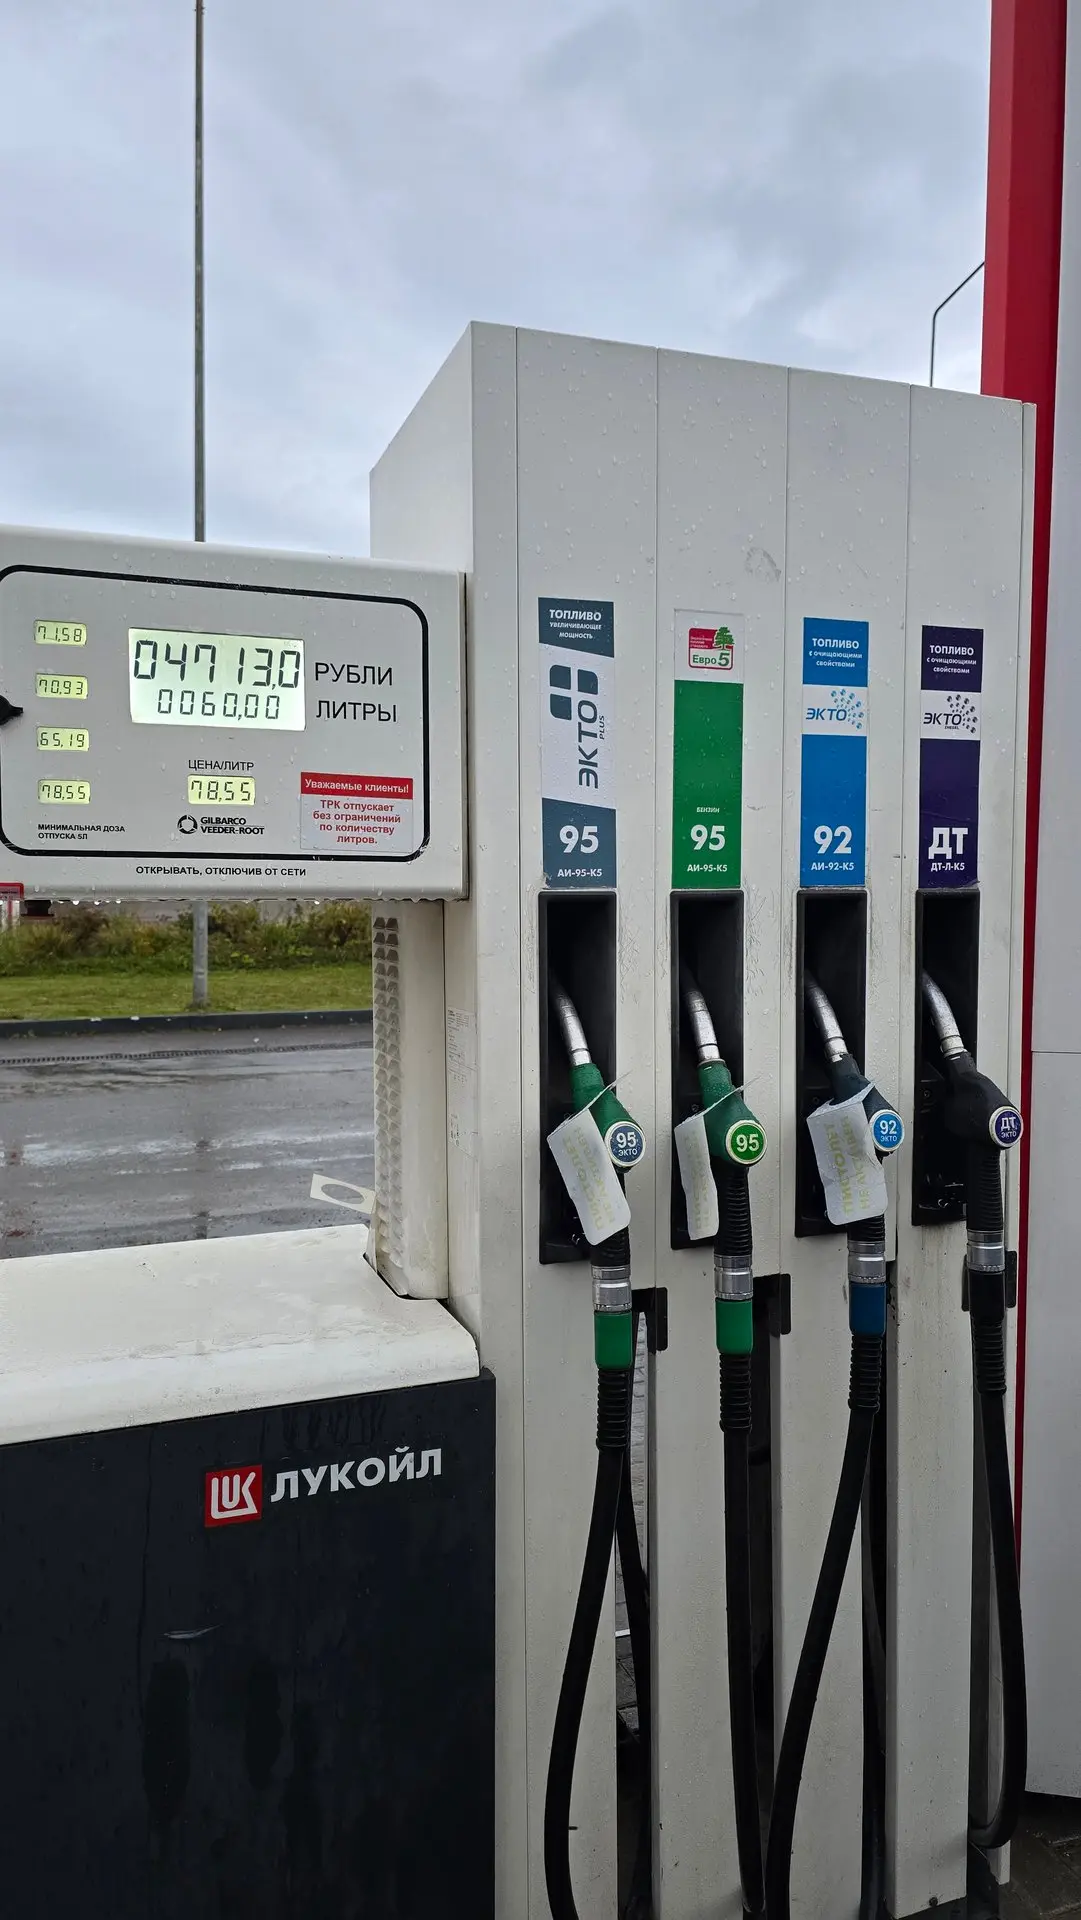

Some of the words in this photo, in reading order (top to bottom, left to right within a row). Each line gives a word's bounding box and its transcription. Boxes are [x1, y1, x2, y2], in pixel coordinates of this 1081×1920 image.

[549, 609, 602, 622] ТОПЛИВО
[38, 626, 82, 642] 71,58
[812, 638, 859, 650] ТОПЛИВО
[929, 645, 974, 656] ТОПЛИВО
[133, 639, 301, 690] 04713,0
[692, 654, 717, 666] Евро
[718, 652, 730, 667] 5
[314, 662, 393, 687] РУБЛИ
[39, 679, 84, 695] 70,93
[157, 688, 281, 721] 0060,00
[316, 700, 398, 723] ЛИТРЫ
[805, 707, 848, 721] ЭКТО
[923, 712, 962, 726] ЭКТО
[40, 732, 85, 748] 65,19
[578, 700, 599, 789] ЭКТО
[188, 760, 255, 771] ЦЕНА/ЛИТР
[42, 785, 86, 800] 78,55
[190, 780, 251, 802] 78,55
[305, 779, 362, 791] Уважаемые
[364, 784, 409, 793] клиенты!
[320, 800, 341, 809] ТРК
[343, 802, 394, 812] отпускает
[200, 816, 247, 826] GILBARCO
[313, 811, 331, 820] без
[334, 813, 401, 823] ограничений
[38, 824, 102, 832] МИНИМАЛЬНАЯ
[103, 825, 126, 833] ДОЗА
[200, 826, 265, 836] VEEDER-ROOT
[320, 823, 333, 831] по
[335, 824, 395, 835] количеству
[38, 832, 76, 840] ОТПУСКА
[336, 835, 378, 845] литров.
[559, 825, 599, 854] 95
[690, 824, 726, 851] 95
[813, 825, 853, 854] 92
[928, 827, 969, 860] ДТ
[135, 866, 202, 876] ОТКРЫВАТЬ,
[205, 867, 262, 876] ОТКЛЮЧИВ
[264, 868, 279, 876] ОТ
[281, 868, 306, 876] СЕТИ
[557, 868, 603, 878] АИ-95-К5
[687, 864, 728, 873] АИ-95-К5
[811, 862, 855, 871] АИ-92-К5
[930, 862, 965, 872] ДТ-Л-К5
[879, 1119, 898, 1136] 92
[1000, 1116, 1018, 1132] ДТ
[616, 1131, 638, 1149] 95
[880, 1135, 898, 1143] ЭКТО
[1000, 1131, 1018, 1139] ЭКТО
[736, 1134, 760, 1152] 95
[618, 1149, 638, 1157] ЭКТО
[270, 1446, 442, 1503] ЛУКОЙЛ
